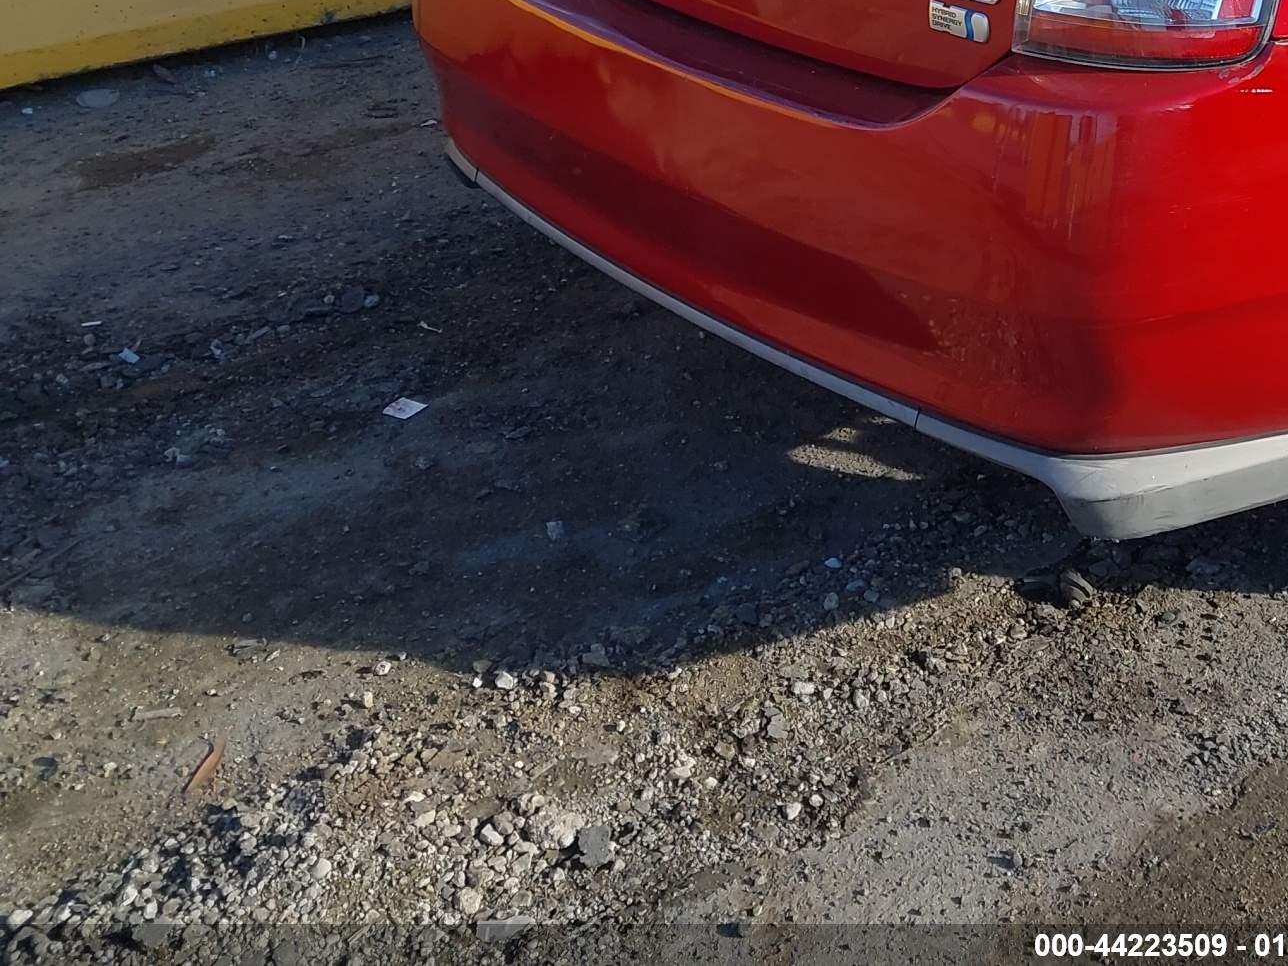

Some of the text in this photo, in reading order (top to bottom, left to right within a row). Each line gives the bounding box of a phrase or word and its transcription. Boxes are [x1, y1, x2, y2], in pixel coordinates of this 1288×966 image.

[931, 6, 957, 19] HYBRID
[931, 13, 963, 27] SYNERGY
[931, 19, 953, 31] DRIVE
